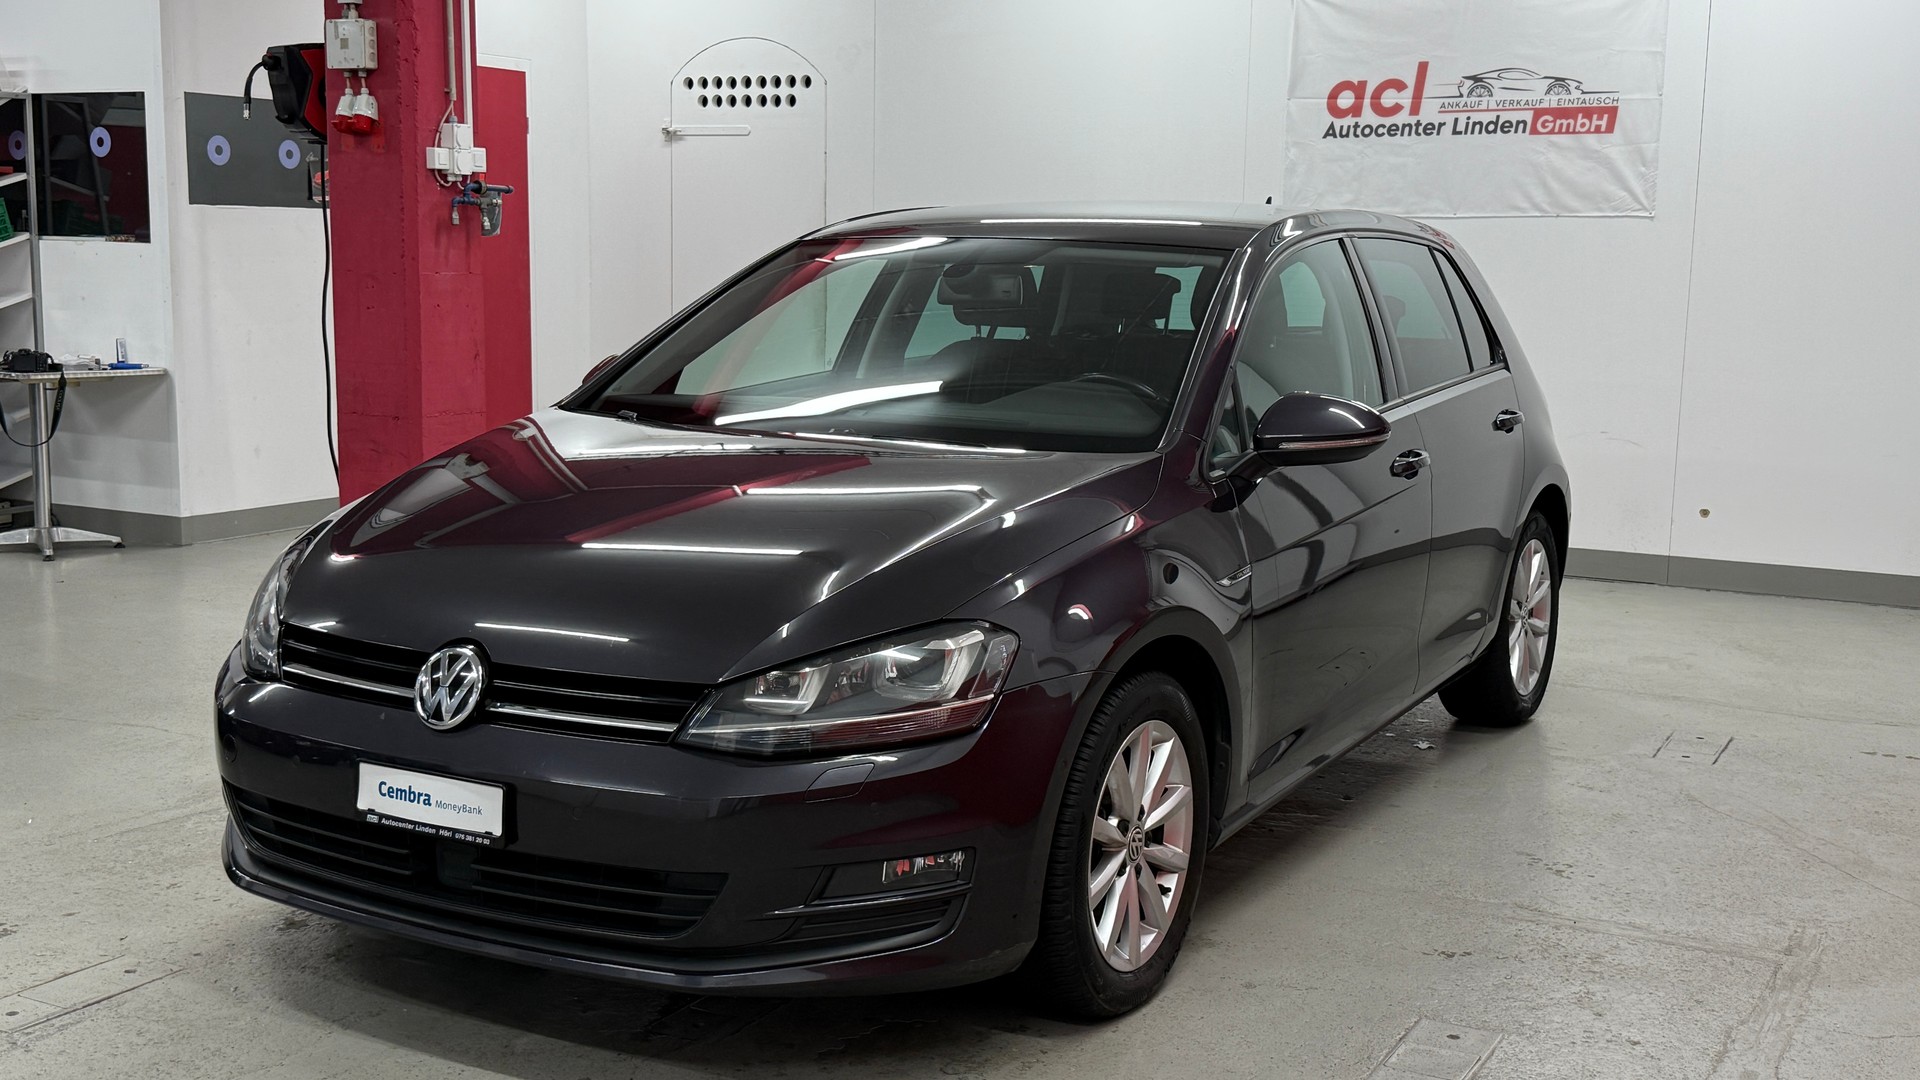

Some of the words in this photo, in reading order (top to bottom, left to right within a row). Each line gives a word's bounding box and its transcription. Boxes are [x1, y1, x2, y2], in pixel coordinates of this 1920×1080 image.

[1326, 61, 1430, 119] acl
[1439, 100, 1484, 110] ANKAUF
[1495, 98, 1545, 108] VERKAUF
[1556, 96, 1620, 107] EINTAUSCH
[1322, 120, 1446, 139] Autocenter
[1451, 115, 1528, 136] Linden
[1536, 113, 1608, 133] GmbH
[378, 780, 432, 807] Cembra
[435, 800, 483, 816] MoneyBank
[381, 817, 415, 830] Autocenter
[416, 824, 436, 834] Linden
